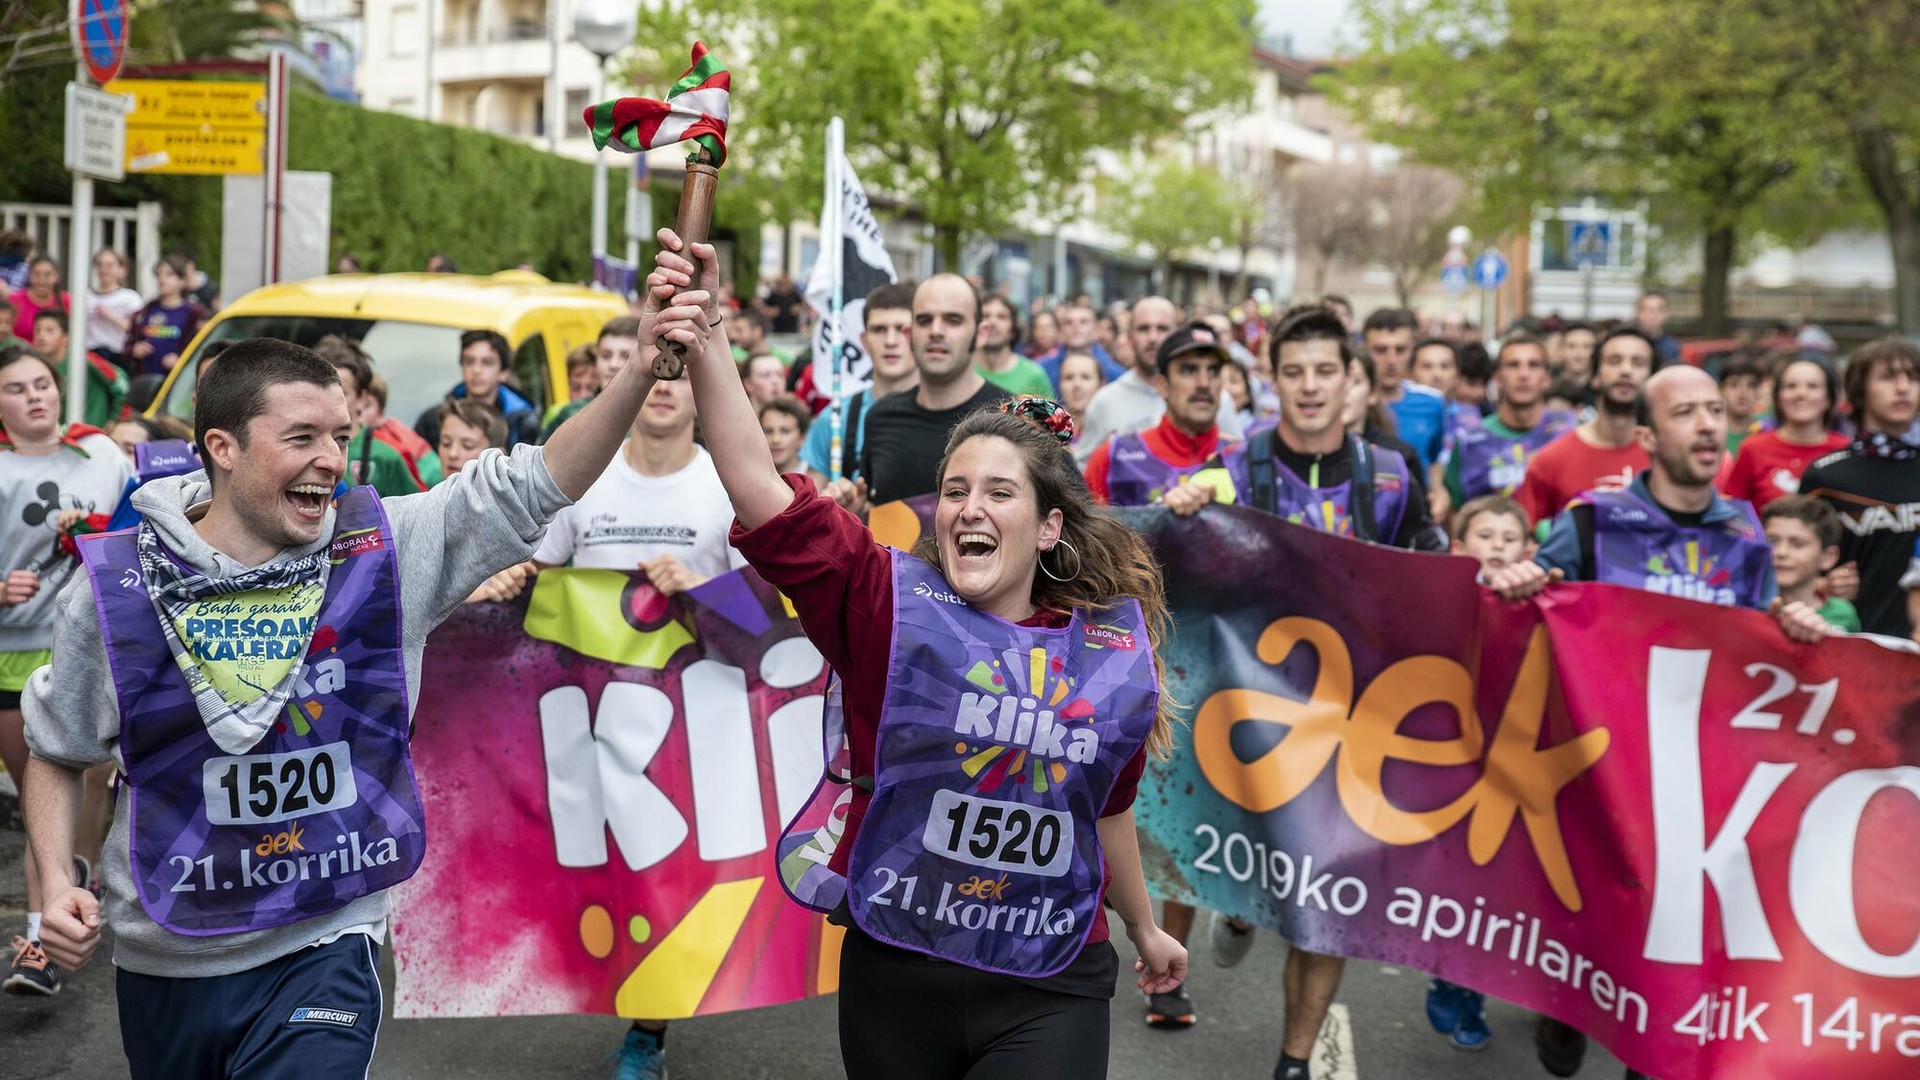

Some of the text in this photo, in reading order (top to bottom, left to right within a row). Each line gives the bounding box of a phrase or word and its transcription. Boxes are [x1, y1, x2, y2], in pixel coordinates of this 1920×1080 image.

[329, 536, 368, 553] ABORAL
[186, 616, 316, 638] PRESOAK
[195, 600, 245, 617] Bada
[192, 637, 303, 661] KALERA
[1085, 628, 1123, 643] LABORAL
[236, 652, 266, 668] free
[1729, 662, 1858, 745] 21.
[954, 692, 1099, 765] Klika
[1195, 616, 1610, 912] aek
[220, 751, 336, 819] 1520
[255, 820, 306, 857] aek
[947, 801, 1062, 867] 1520
[168, 830, 400, 892] 21. korrika
[867, 866, 1077, 936] 21. korrika
[958, 873, 1013, 900] aek
[1193, 823, 1369, 916] 2019ko
[1385, 885, 1649, 1034] apirilaren
[306, 1010, 356, 1024] MERCURY
